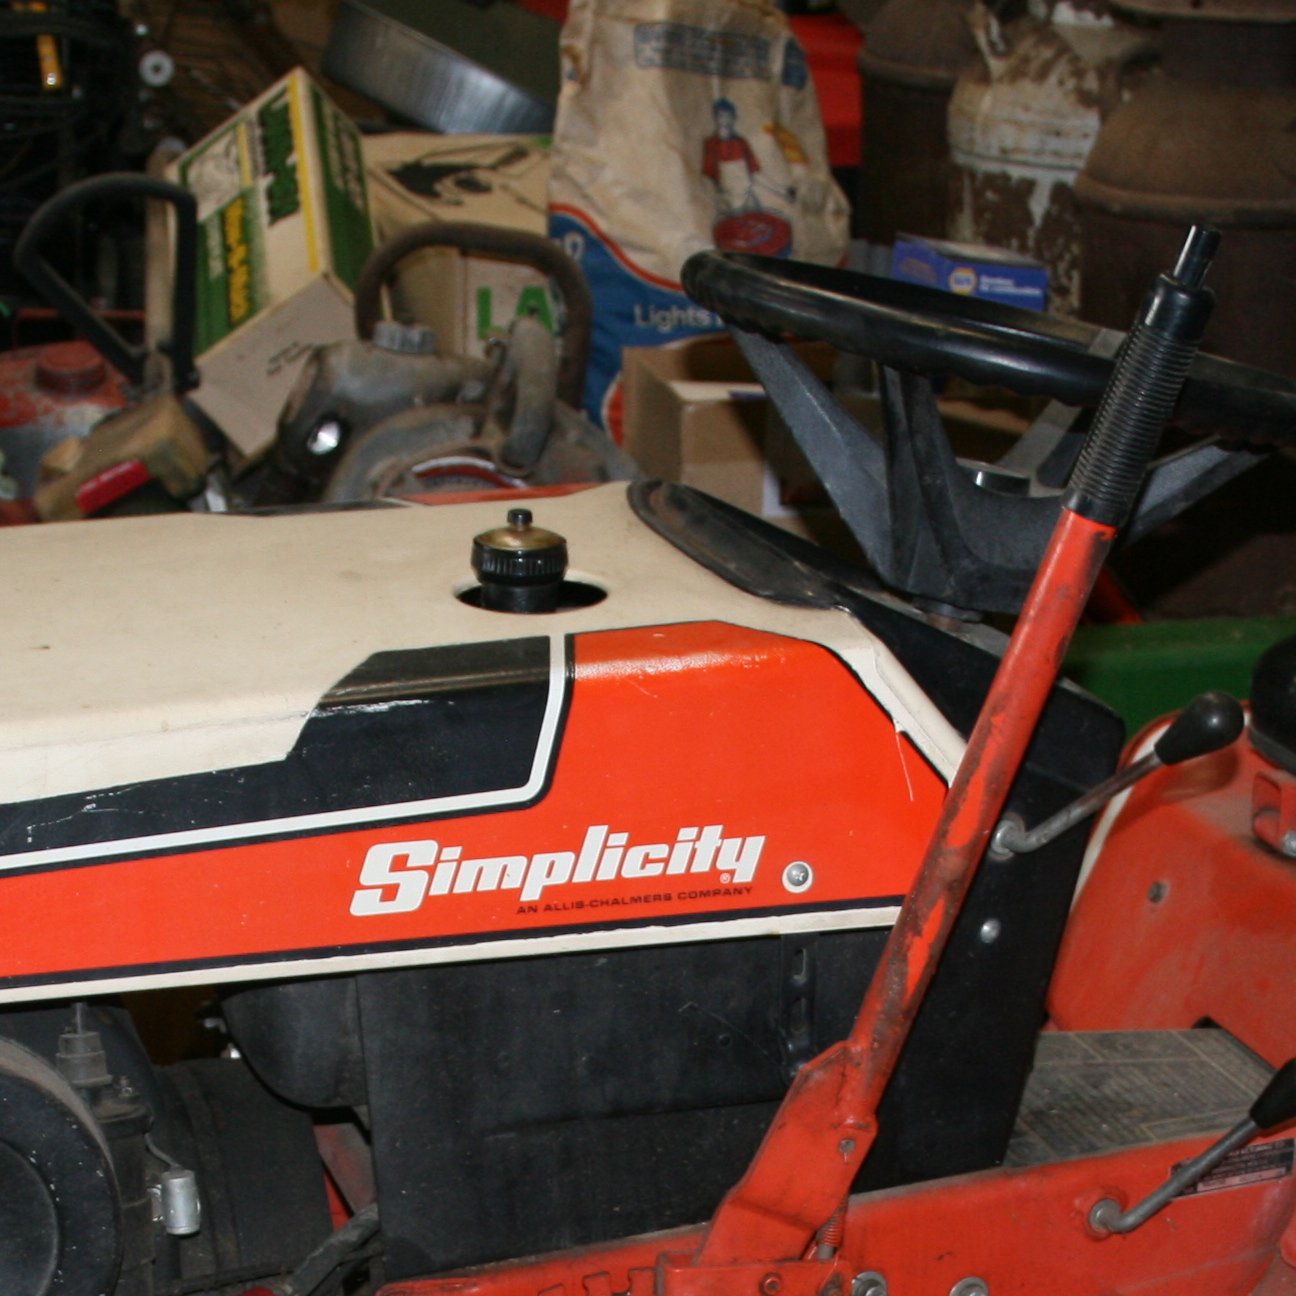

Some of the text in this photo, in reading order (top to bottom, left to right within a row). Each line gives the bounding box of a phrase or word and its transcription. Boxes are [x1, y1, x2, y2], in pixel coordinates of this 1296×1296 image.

[634, 304, 711, 328] Lights
[349, 824, 766, 916] Simplicity
[516, 886, 753, 915] AN ALLIS-CHALMERS COMPANY
